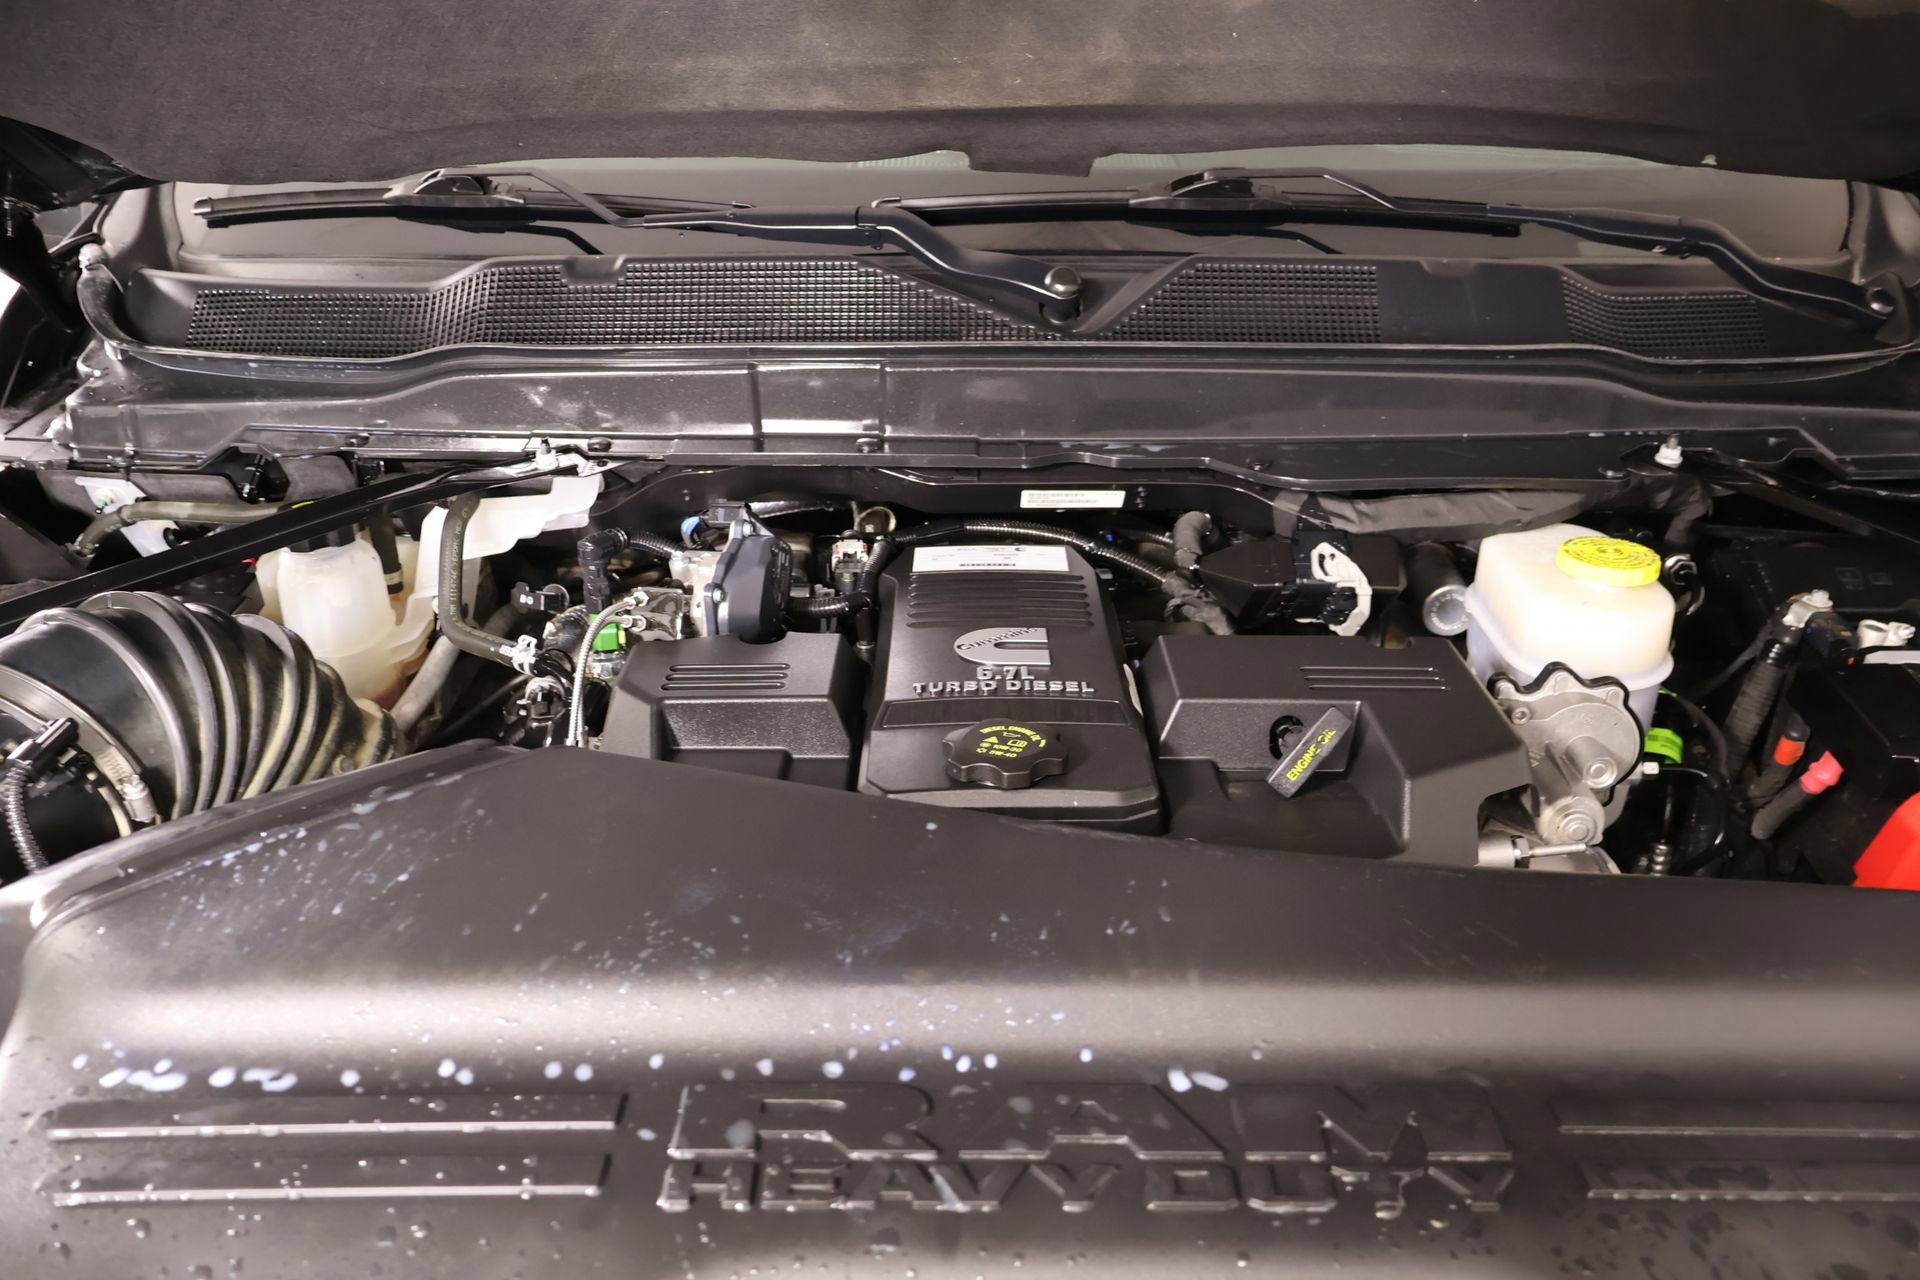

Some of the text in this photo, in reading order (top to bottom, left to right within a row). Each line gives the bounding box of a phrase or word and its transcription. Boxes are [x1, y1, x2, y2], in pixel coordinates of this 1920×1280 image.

[956, 627, 1038, 650] Cummins
[912, 680, 1095, 694] TURBO DIESEL
[977, 666, 1035, 680] 6.7L
[1286, 727, 1337, 782] ENGINE OIL
[667, 1081, 1513, 1161] RAM
[657, 1162, 1515, 1214] HEAVY DUTY
